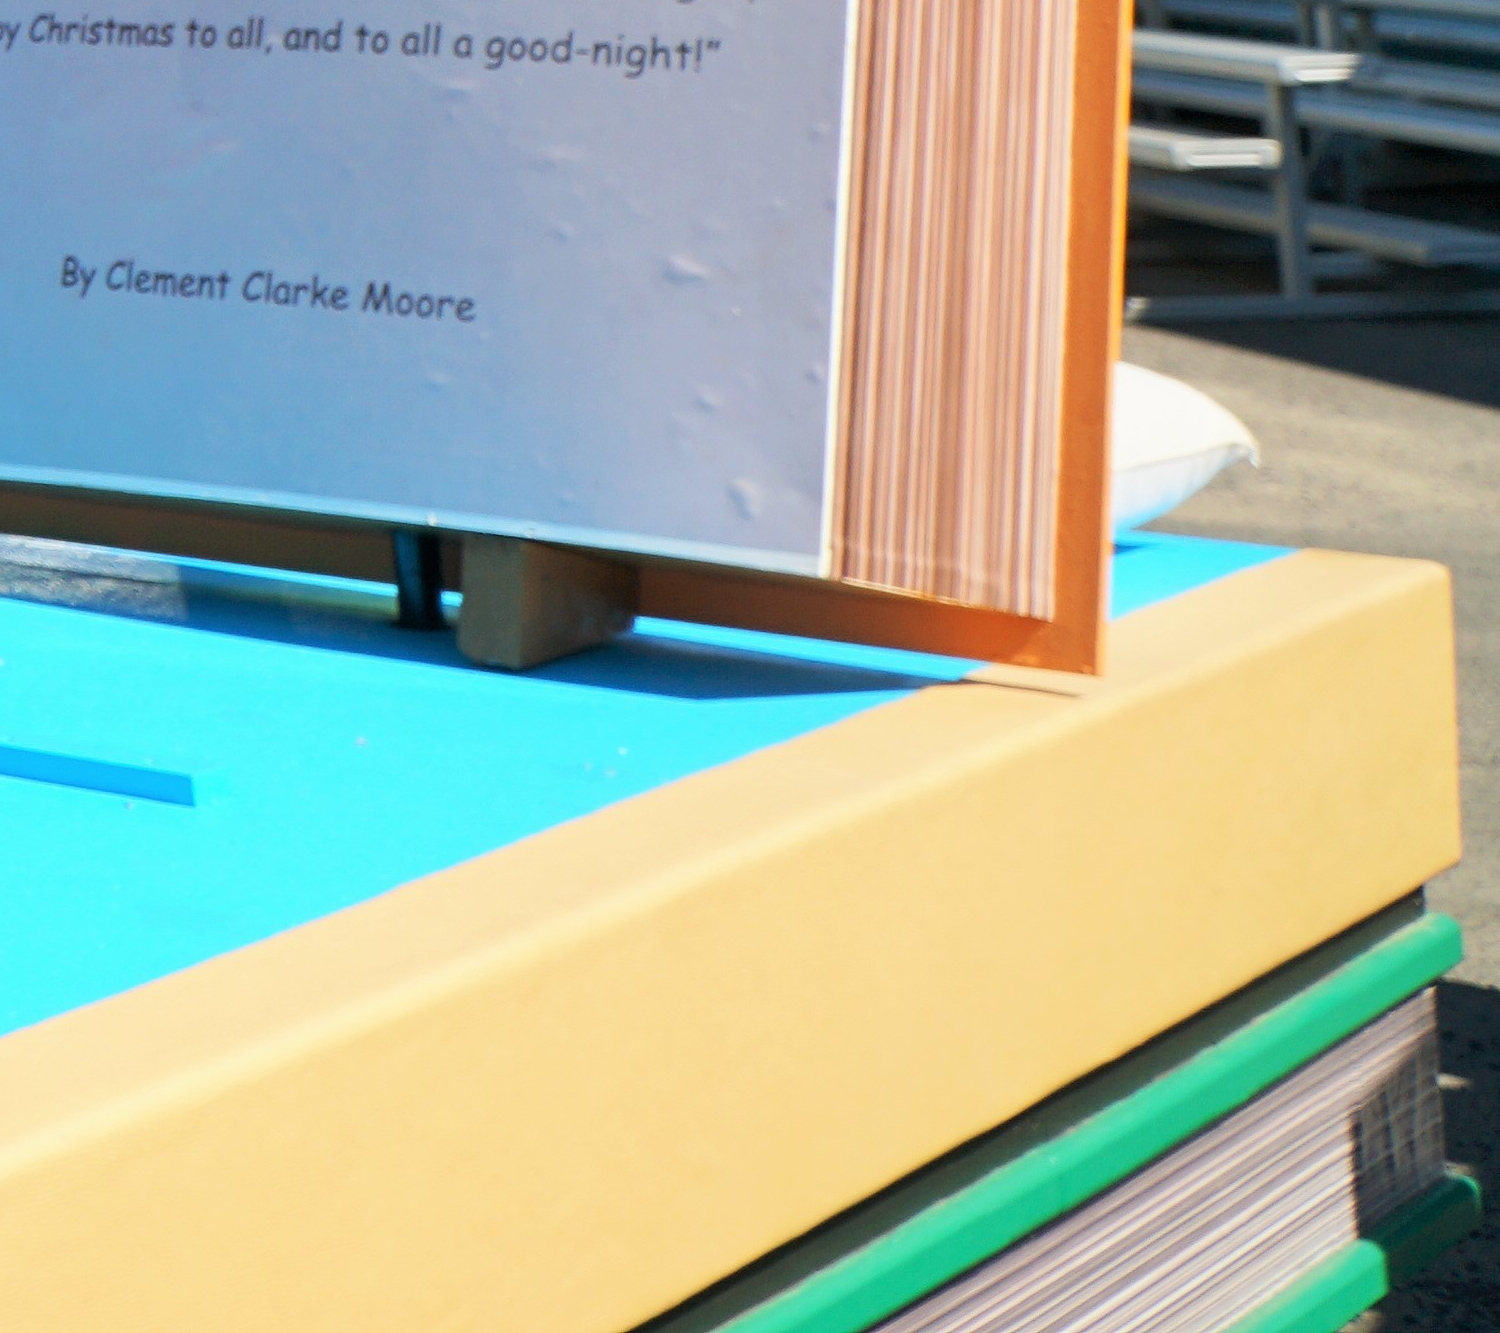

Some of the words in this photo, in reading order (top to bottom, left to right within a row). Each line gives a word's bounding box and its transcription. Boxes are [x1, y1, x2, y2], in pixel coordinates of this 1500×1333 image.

[28, 12, 176, 48] Christmas
[185, 18, 218, 49] to
[283, 19, 344, 53] and
[354, 23, 391, 55] to
[400, 22, 443, 57] all
[452, 34, 474, 59] a
[60, 255, 97, 299] By
[105, 258, 232, 300] Clement
[241, 270, 350, 311] Clarke
[361, 281, 476, 323] Moore
